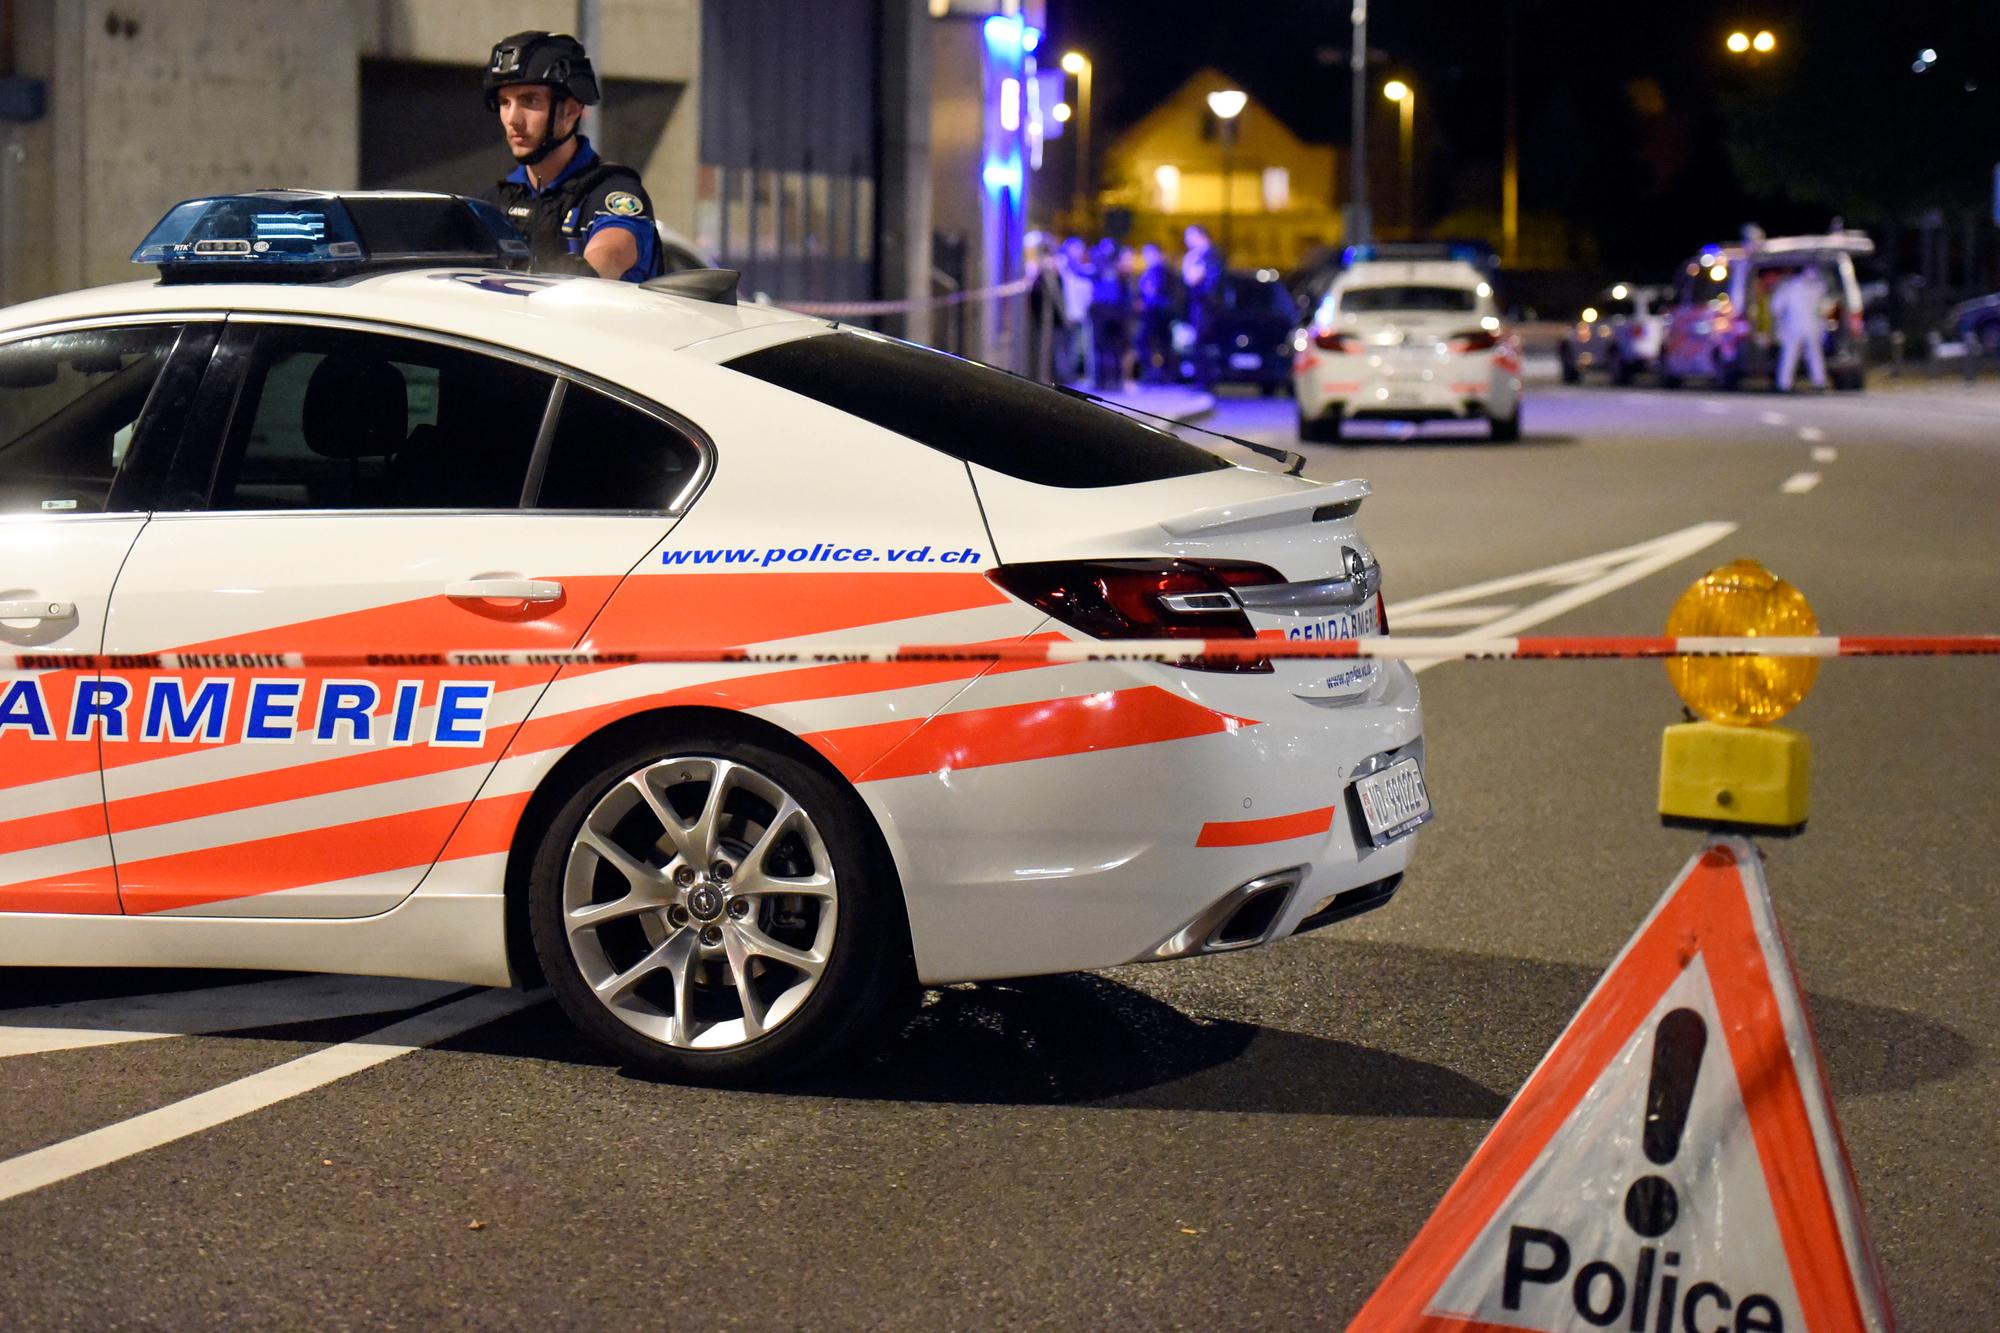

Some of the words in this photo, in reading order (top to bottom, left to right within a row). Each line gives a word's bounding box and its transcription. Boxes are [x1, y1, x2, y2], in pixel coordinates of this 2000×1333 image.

[661, 543, 982, 567] www.police.vd.ch
[19, 655, 98, 669] POLICE
[109, 655, 161, 669] ZONE
[177, 654, 287, 668] INTERDITE
[0, 679, 491, 743] ARMERIE
[1501, 1225, 1785, 1333] Police
